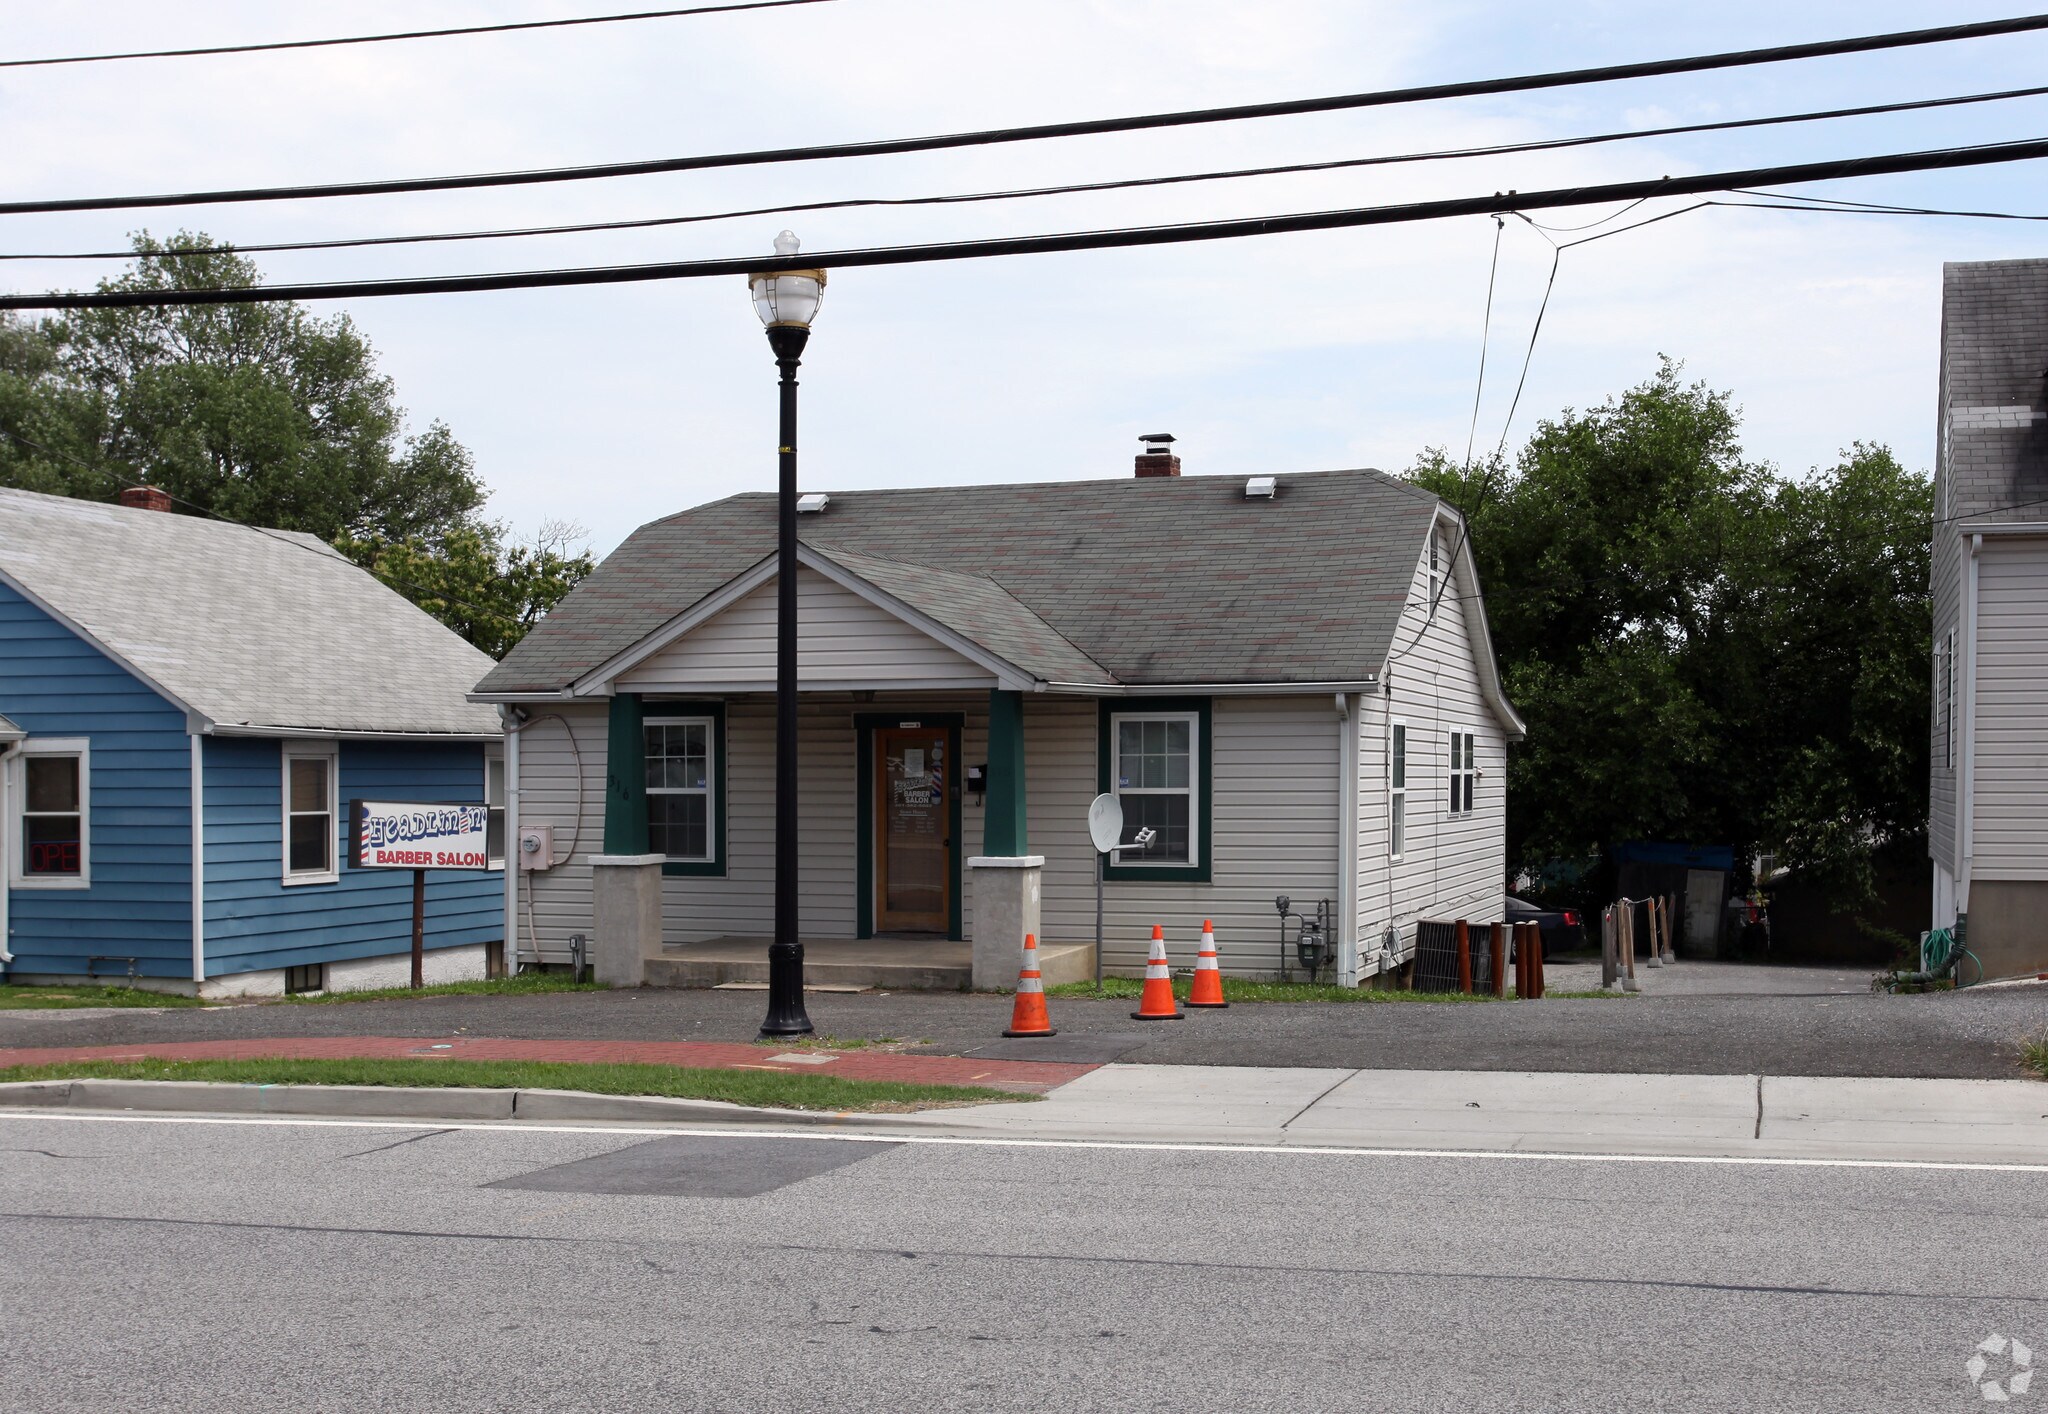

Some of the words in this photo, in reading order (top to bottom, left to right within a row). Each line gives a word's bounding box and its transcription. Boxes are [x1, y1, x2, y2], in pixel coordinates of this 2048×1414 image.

[609, 774, 629, 800] 316
[31, 844, 80, 871] OPE
[377, 851, 432, 864] BARBER
[437, 853, 484, 865] SALON
